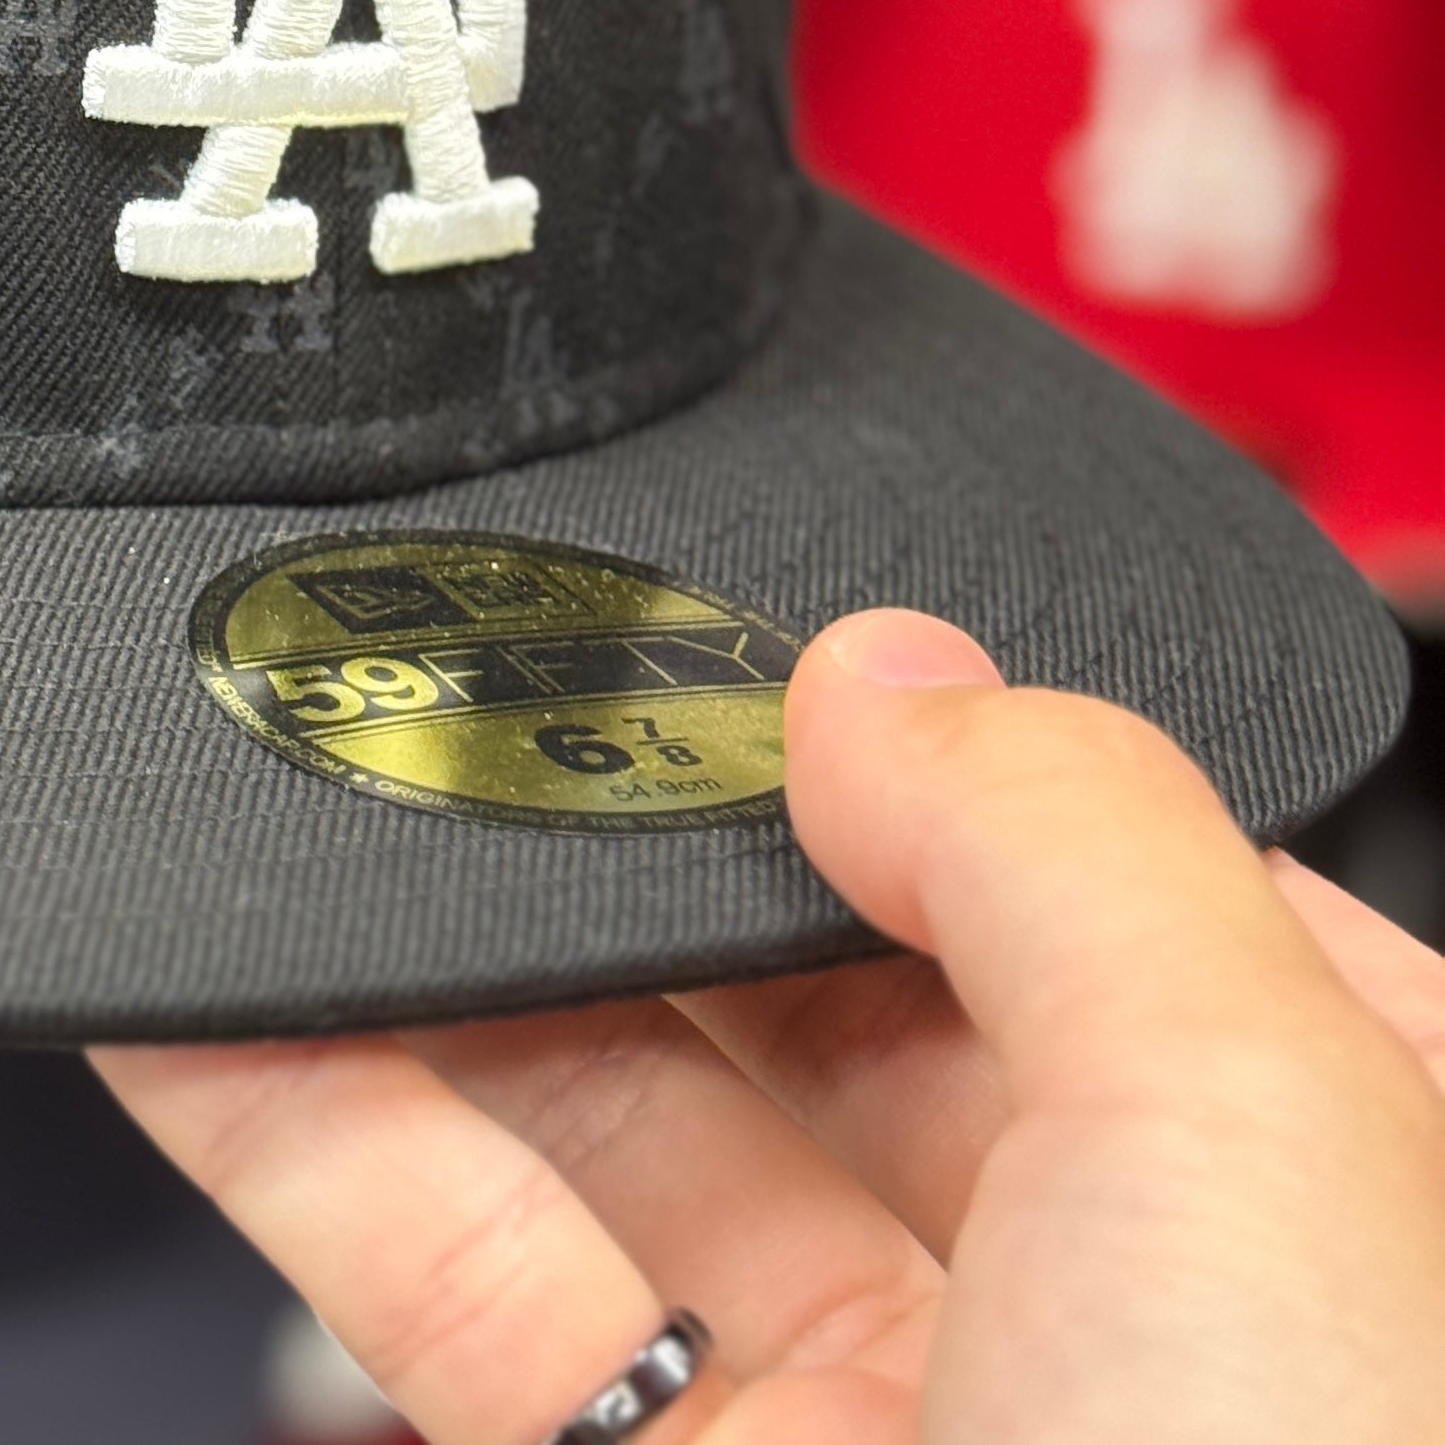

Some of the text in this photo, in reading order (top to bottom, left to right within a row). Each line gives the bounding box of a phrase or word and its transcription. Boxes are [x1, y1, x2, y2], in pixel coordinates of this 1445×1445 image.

[265, 630, 764, 722] 59FIFTY
[534, 723, 636, 775] 6
[608, 776, 723, 803] 54.9cm
[589, 815, 633, 829] THE
[643, 812, 707, 827] TRUE
